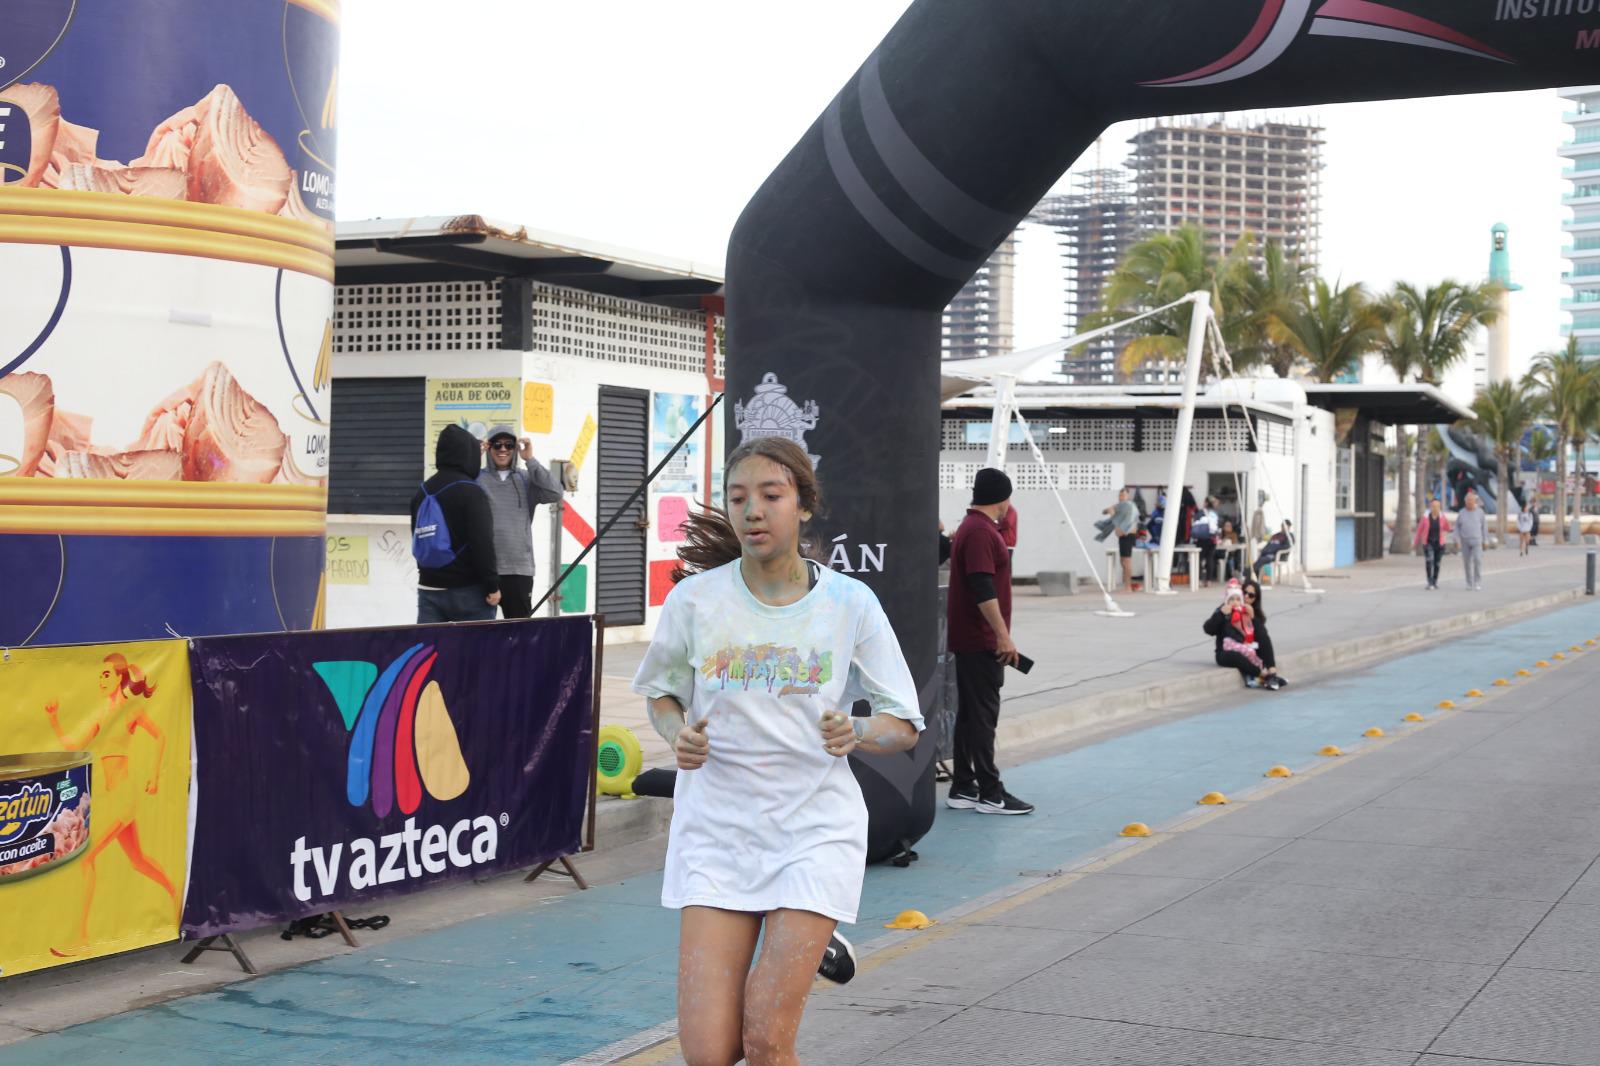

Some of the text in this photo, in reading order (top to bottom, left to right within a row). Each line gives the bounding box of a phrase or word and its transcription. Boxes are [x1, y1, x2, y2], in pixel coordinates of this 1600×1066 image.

[435, 390, 463, 401] AGUA
[468, 390, 481, 401] DE
[485, 389, 511, 401] COCO
[19, 838, 48, 857] aceite
[290, 836, 343, 902] tv
